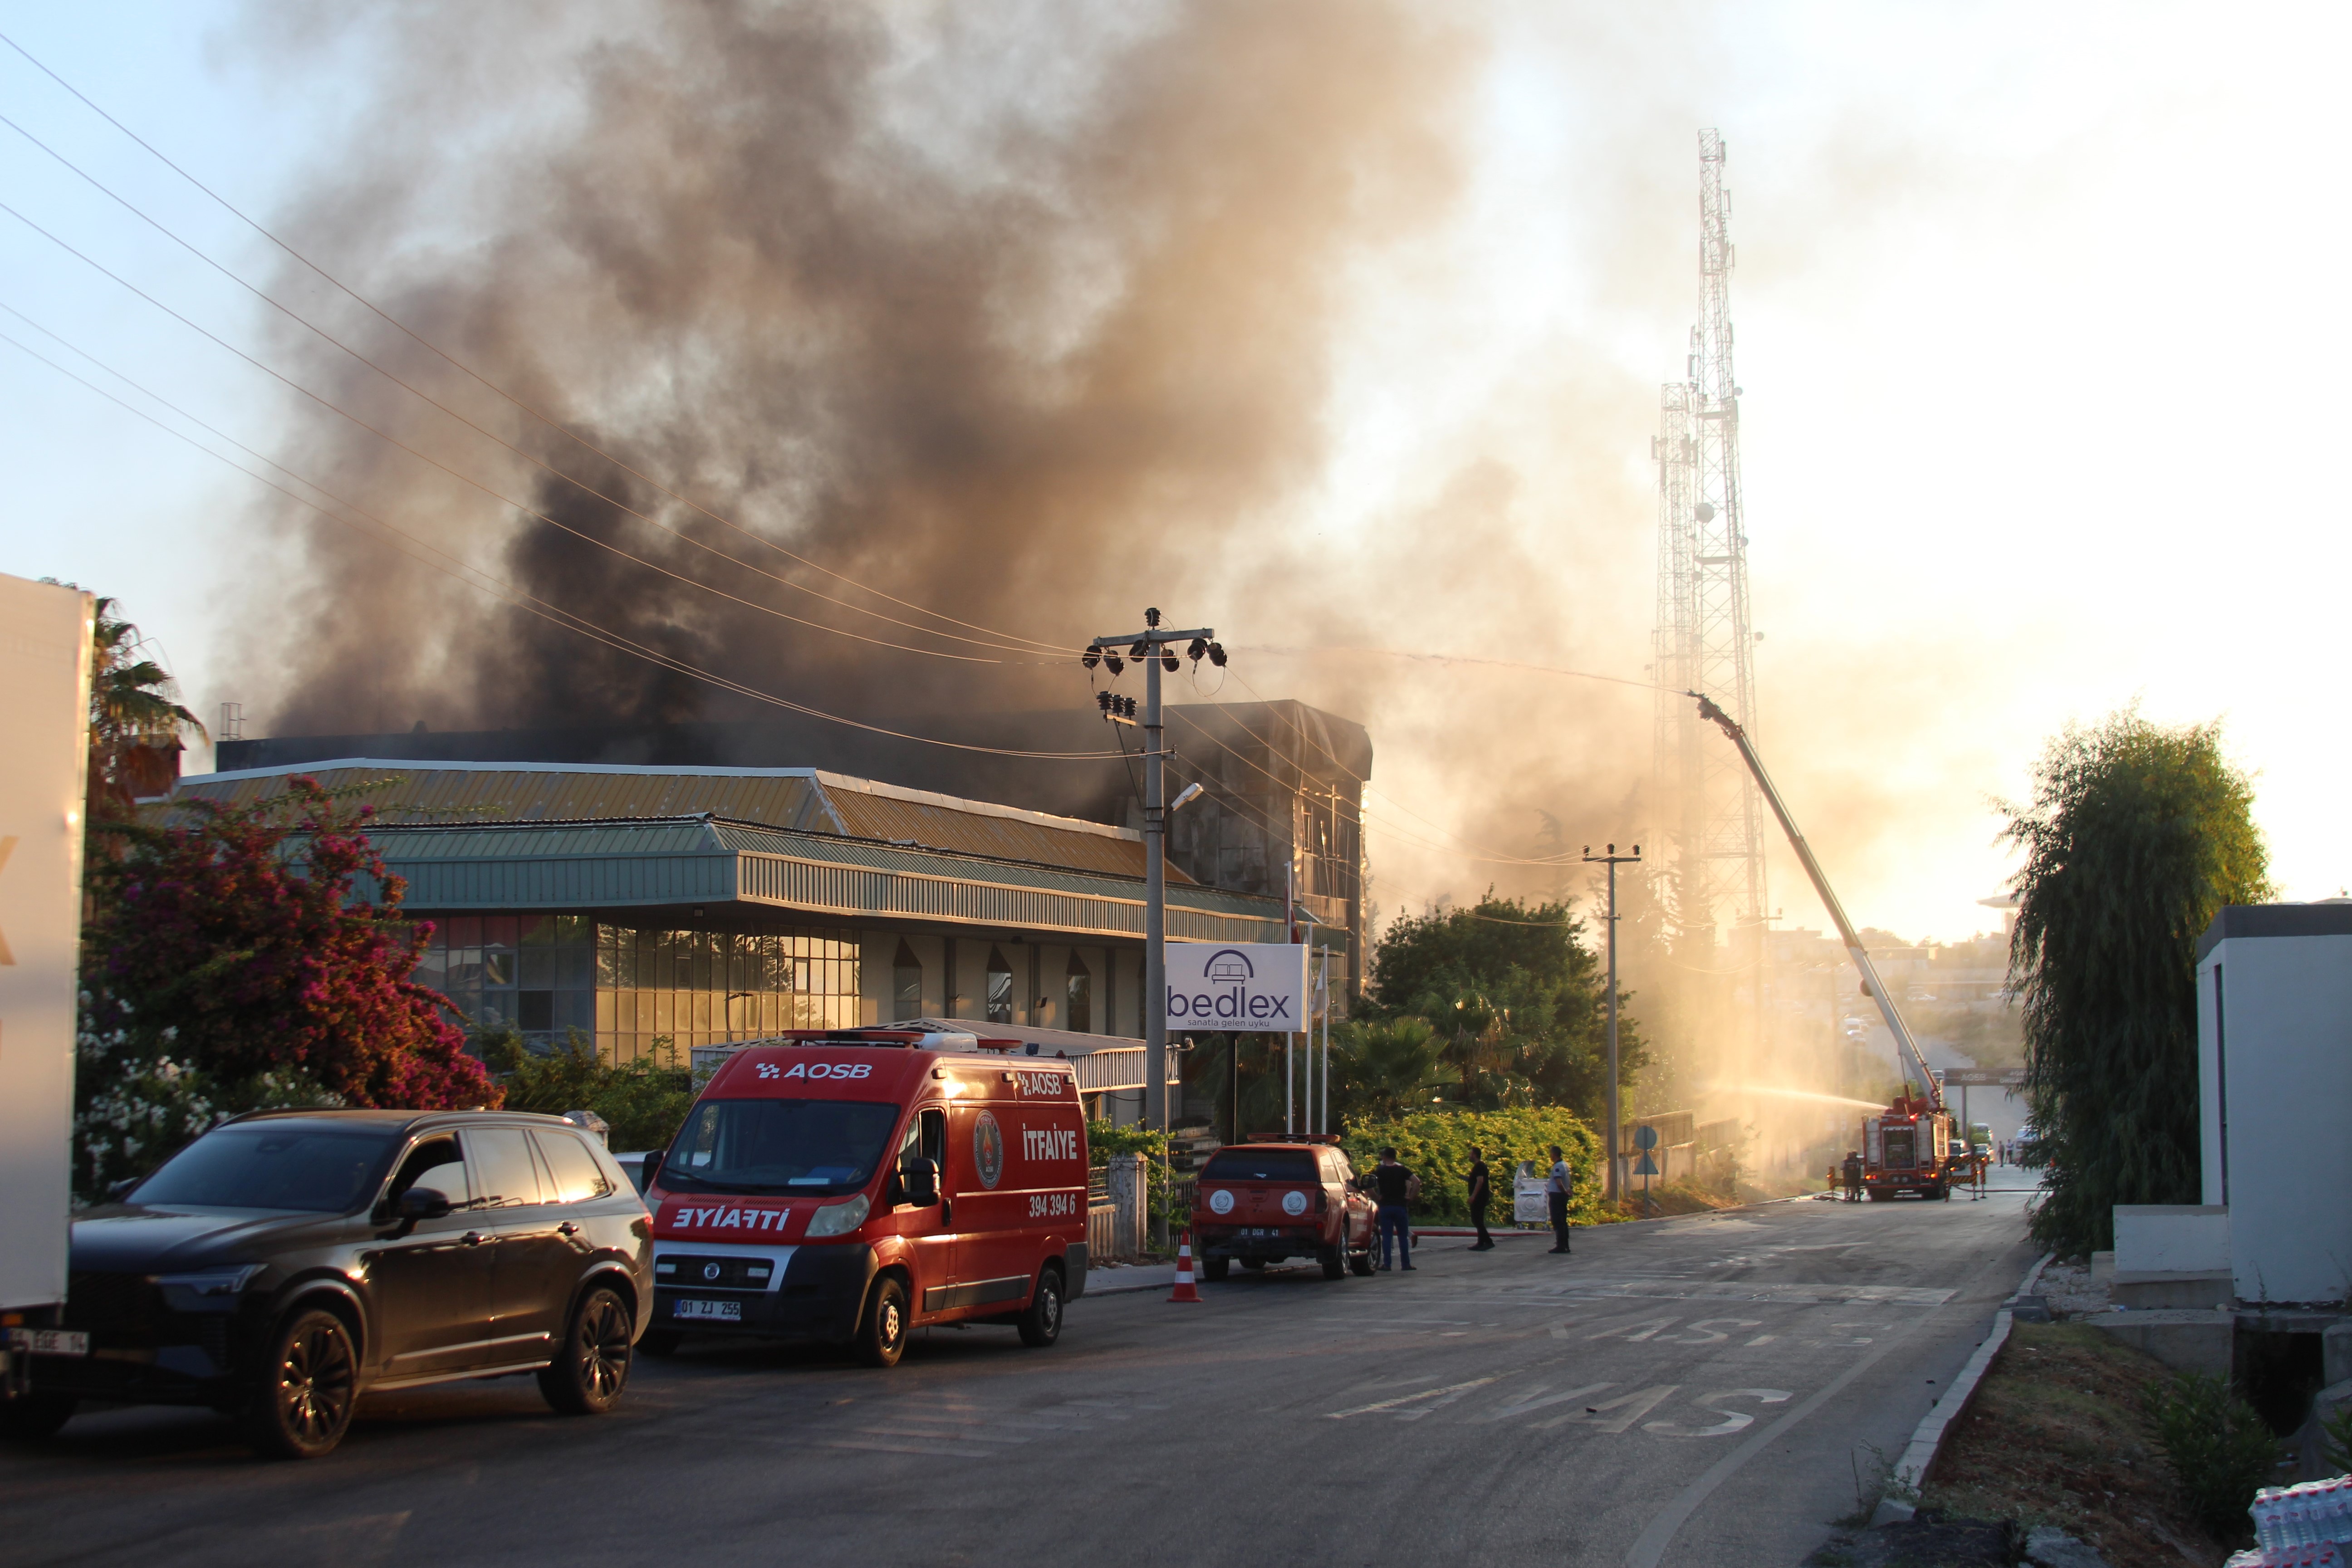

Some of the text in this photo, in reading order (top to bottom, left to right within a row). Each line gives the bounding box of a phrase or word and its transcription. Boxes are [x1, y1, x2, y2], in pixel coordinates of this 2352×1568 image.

[1167, 985, 1289, 1018] bedlex
[1221, 1019, 1245, 1028] gelen
[1248, 1019, 1269, 1028] uyku
[784, 1063, 872, 1079] AOSB
[1031, 1073, 1062, 1095] AOSB
[1023, 1122, 1078, 1161] İTFAİYE
[1029, 1193, 1076, 1218] 394 394 6
[1252, 1228, 1264, 1236] DGR
[682, 1300, 740, 1315] 01 ZJ 255
